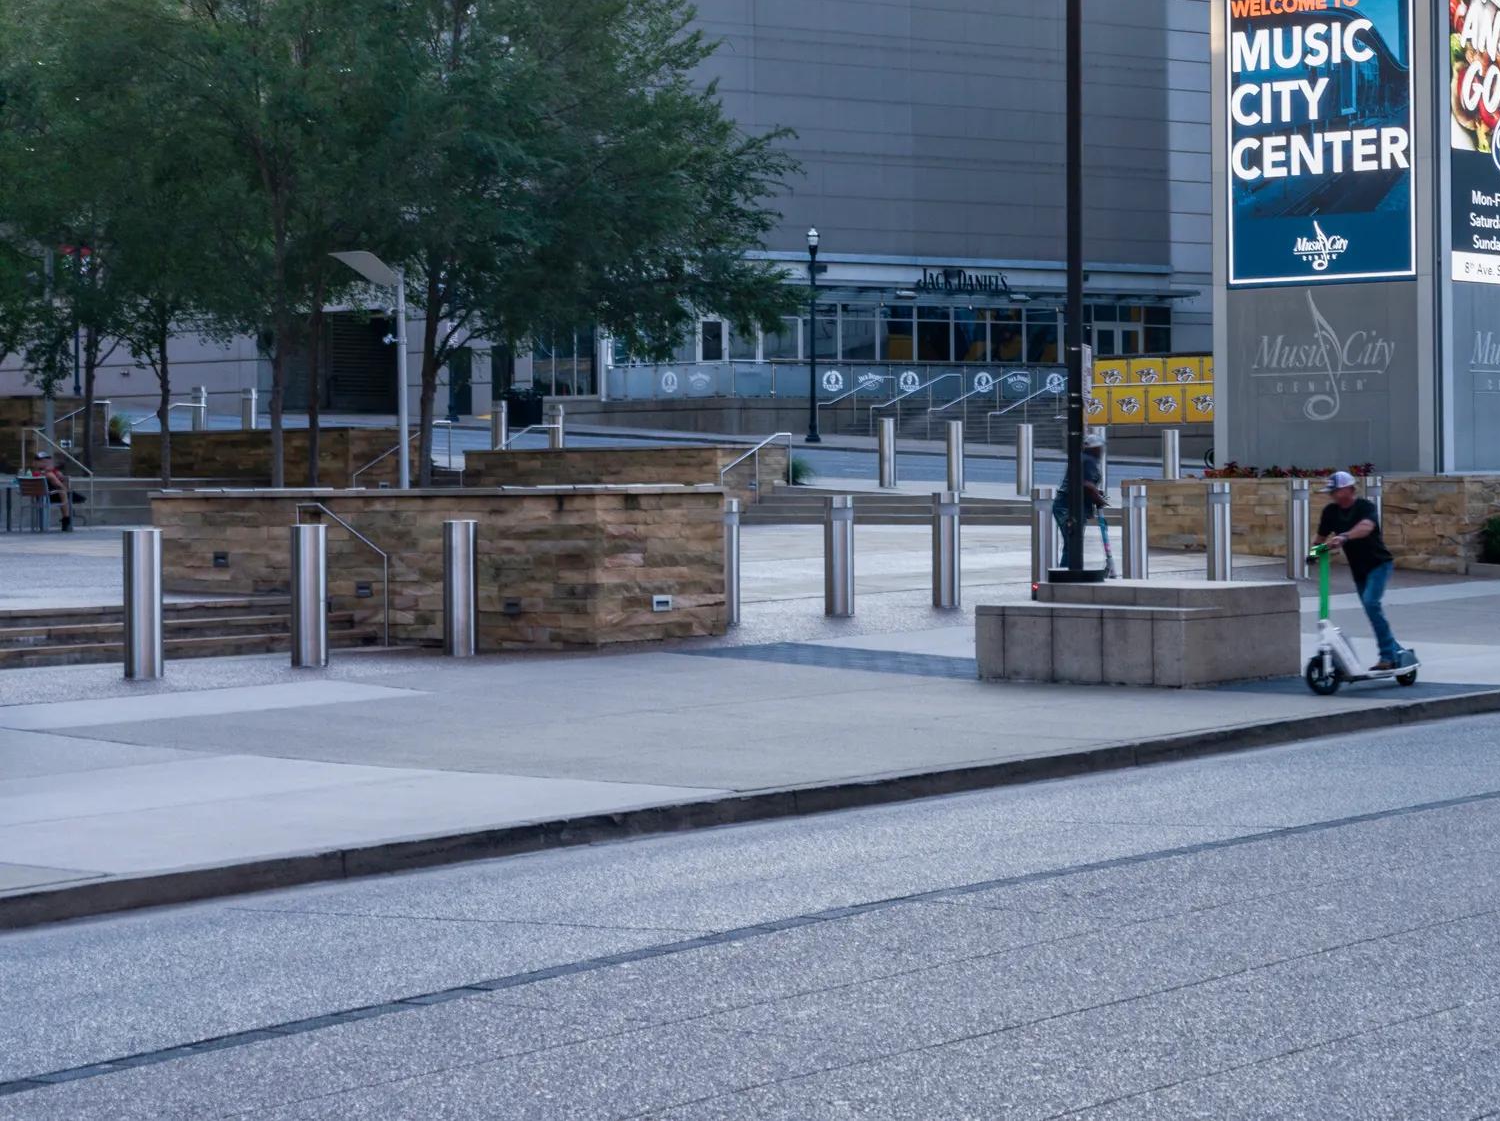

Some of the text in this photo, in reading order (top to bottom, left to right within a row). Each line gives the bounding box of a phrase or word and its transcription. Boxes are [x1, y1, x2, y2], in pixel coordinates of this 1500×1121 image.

[1231, 18, 1375, 73] MUSIC
[1231, 77, 1330, 127] CITY
[1232, 126, 1410, 181] CENTER
[916, 267, 1009, 291] JACK DANIEL'S
[1477, 263, 1495, 276] Ave.
[1251, 330, 1396, 375] Music City
[1276, 380, 1364, 393] CENTER
